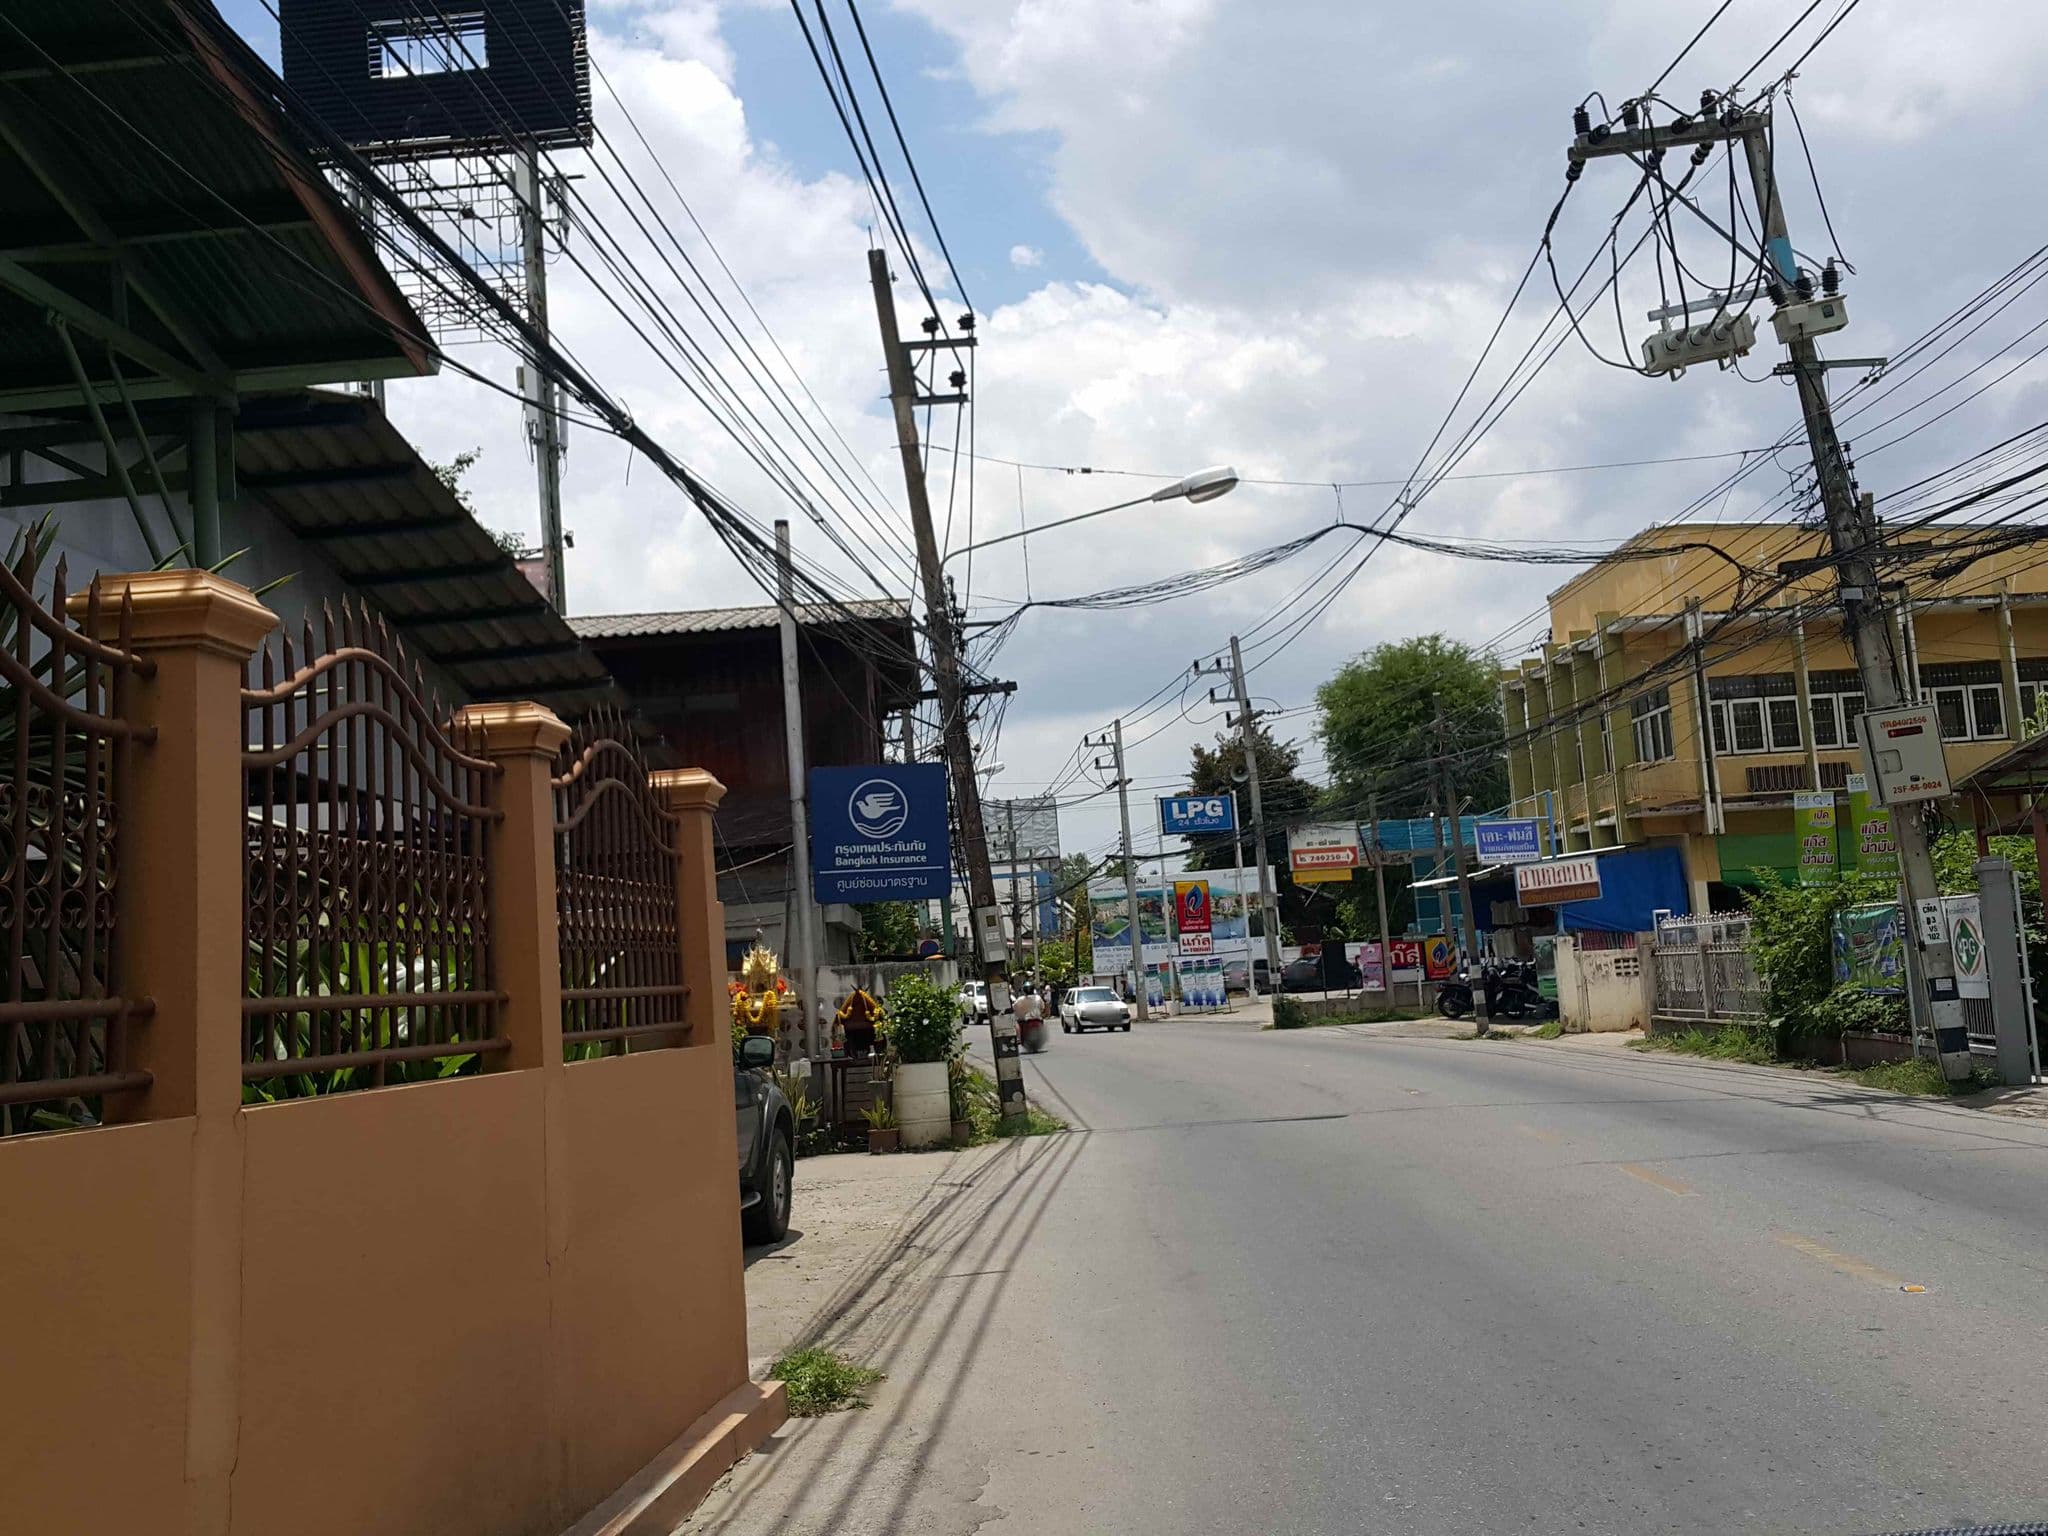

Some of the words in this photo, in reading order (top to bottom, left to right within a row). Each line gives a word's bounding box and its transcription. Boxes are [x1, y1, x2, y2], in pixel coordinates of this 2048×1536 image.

[1172, 799, 1223, 818] LPG
[835, 840, 926, 857] กรุงเทพประกันภัย
[1861, 836, 1896, 854] น้ำมัน
[835, 855, 878, 868] Bangkok
[880, 855, 927, 864] Insurance
[837, 875, 928, 892] ศูนย์ซ่อมมาตรฐาน
[1922, 905, 1938, 914] CMA
[1390, 943, 1420, 965] ก๊ส
